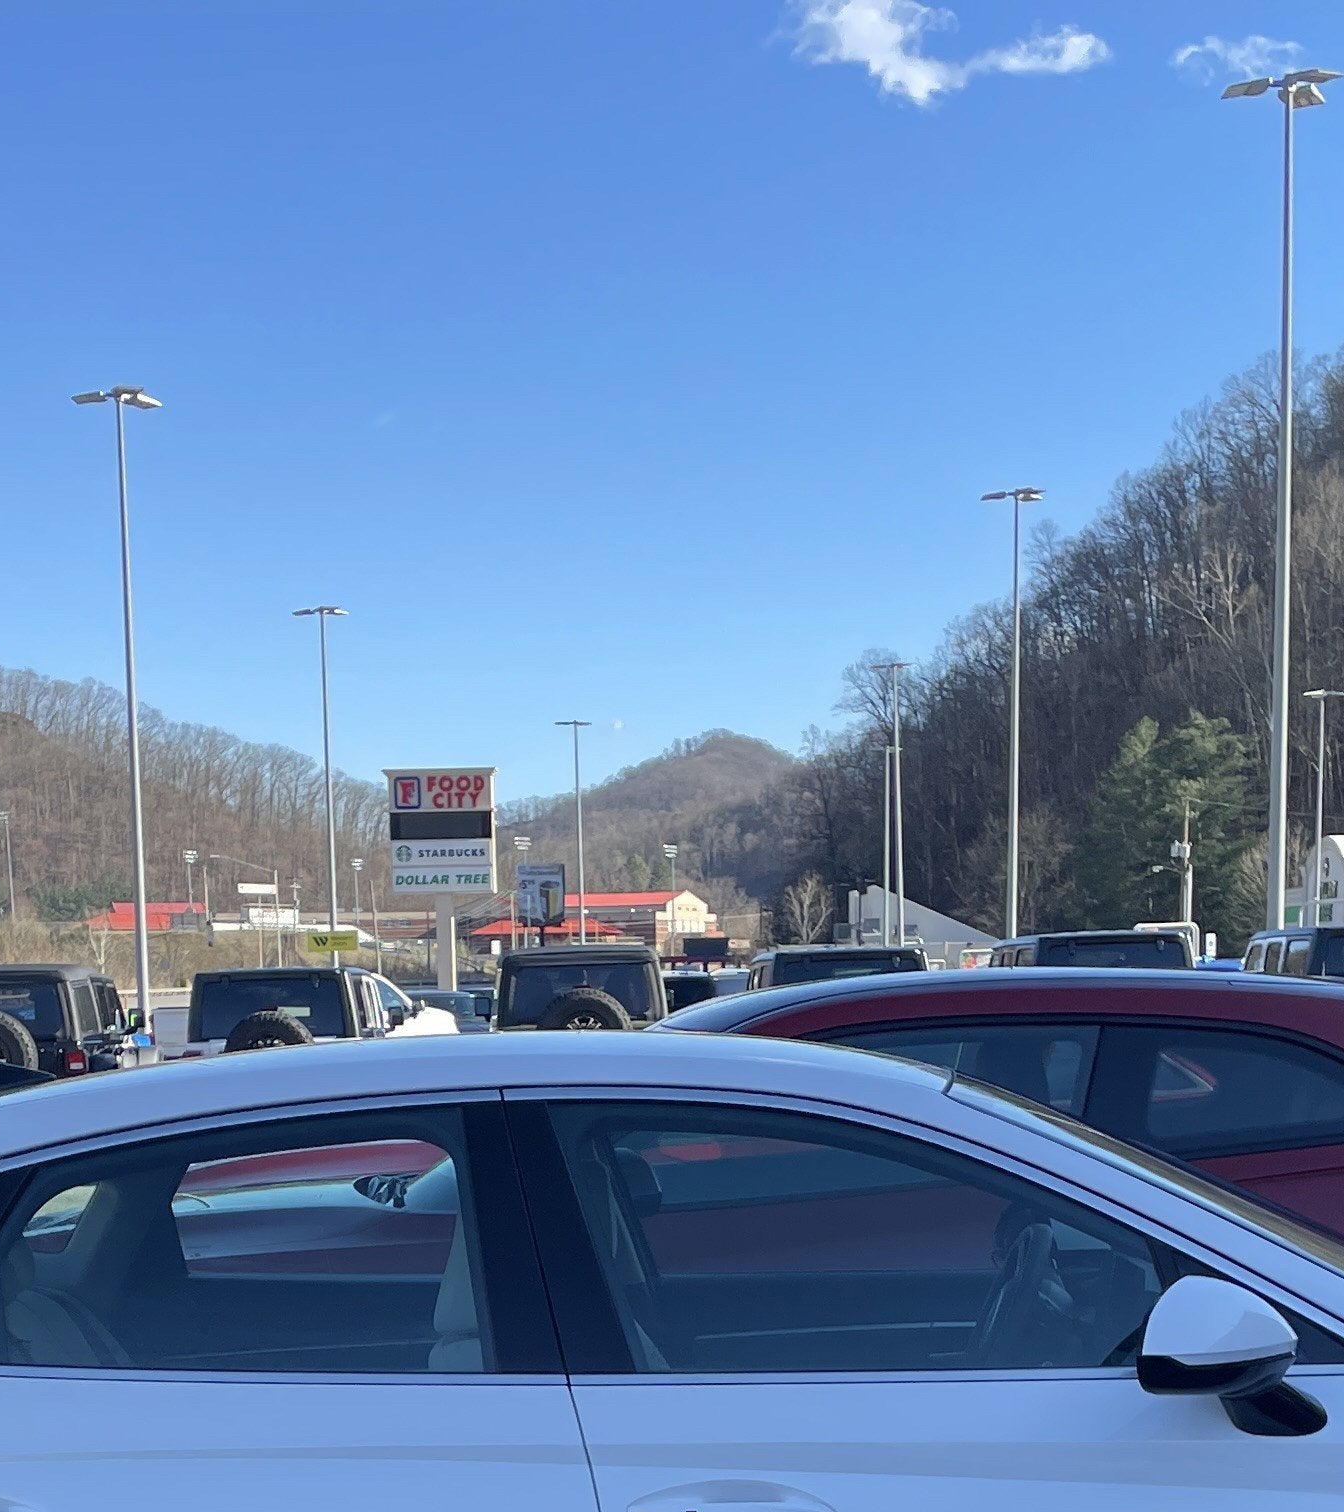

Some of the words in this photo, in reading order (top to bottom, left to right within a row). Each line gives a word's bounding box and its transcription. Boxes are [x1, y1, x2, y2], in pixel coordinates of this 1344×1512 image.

[426, 775, 485, 792] FOOD
[432, 793, 480, 809] CITY
[418, 847, 486, 859] STARBUCKS
[395, 874, 449, 886] DOLLAR
[456, 873, 490, 885] TREE
